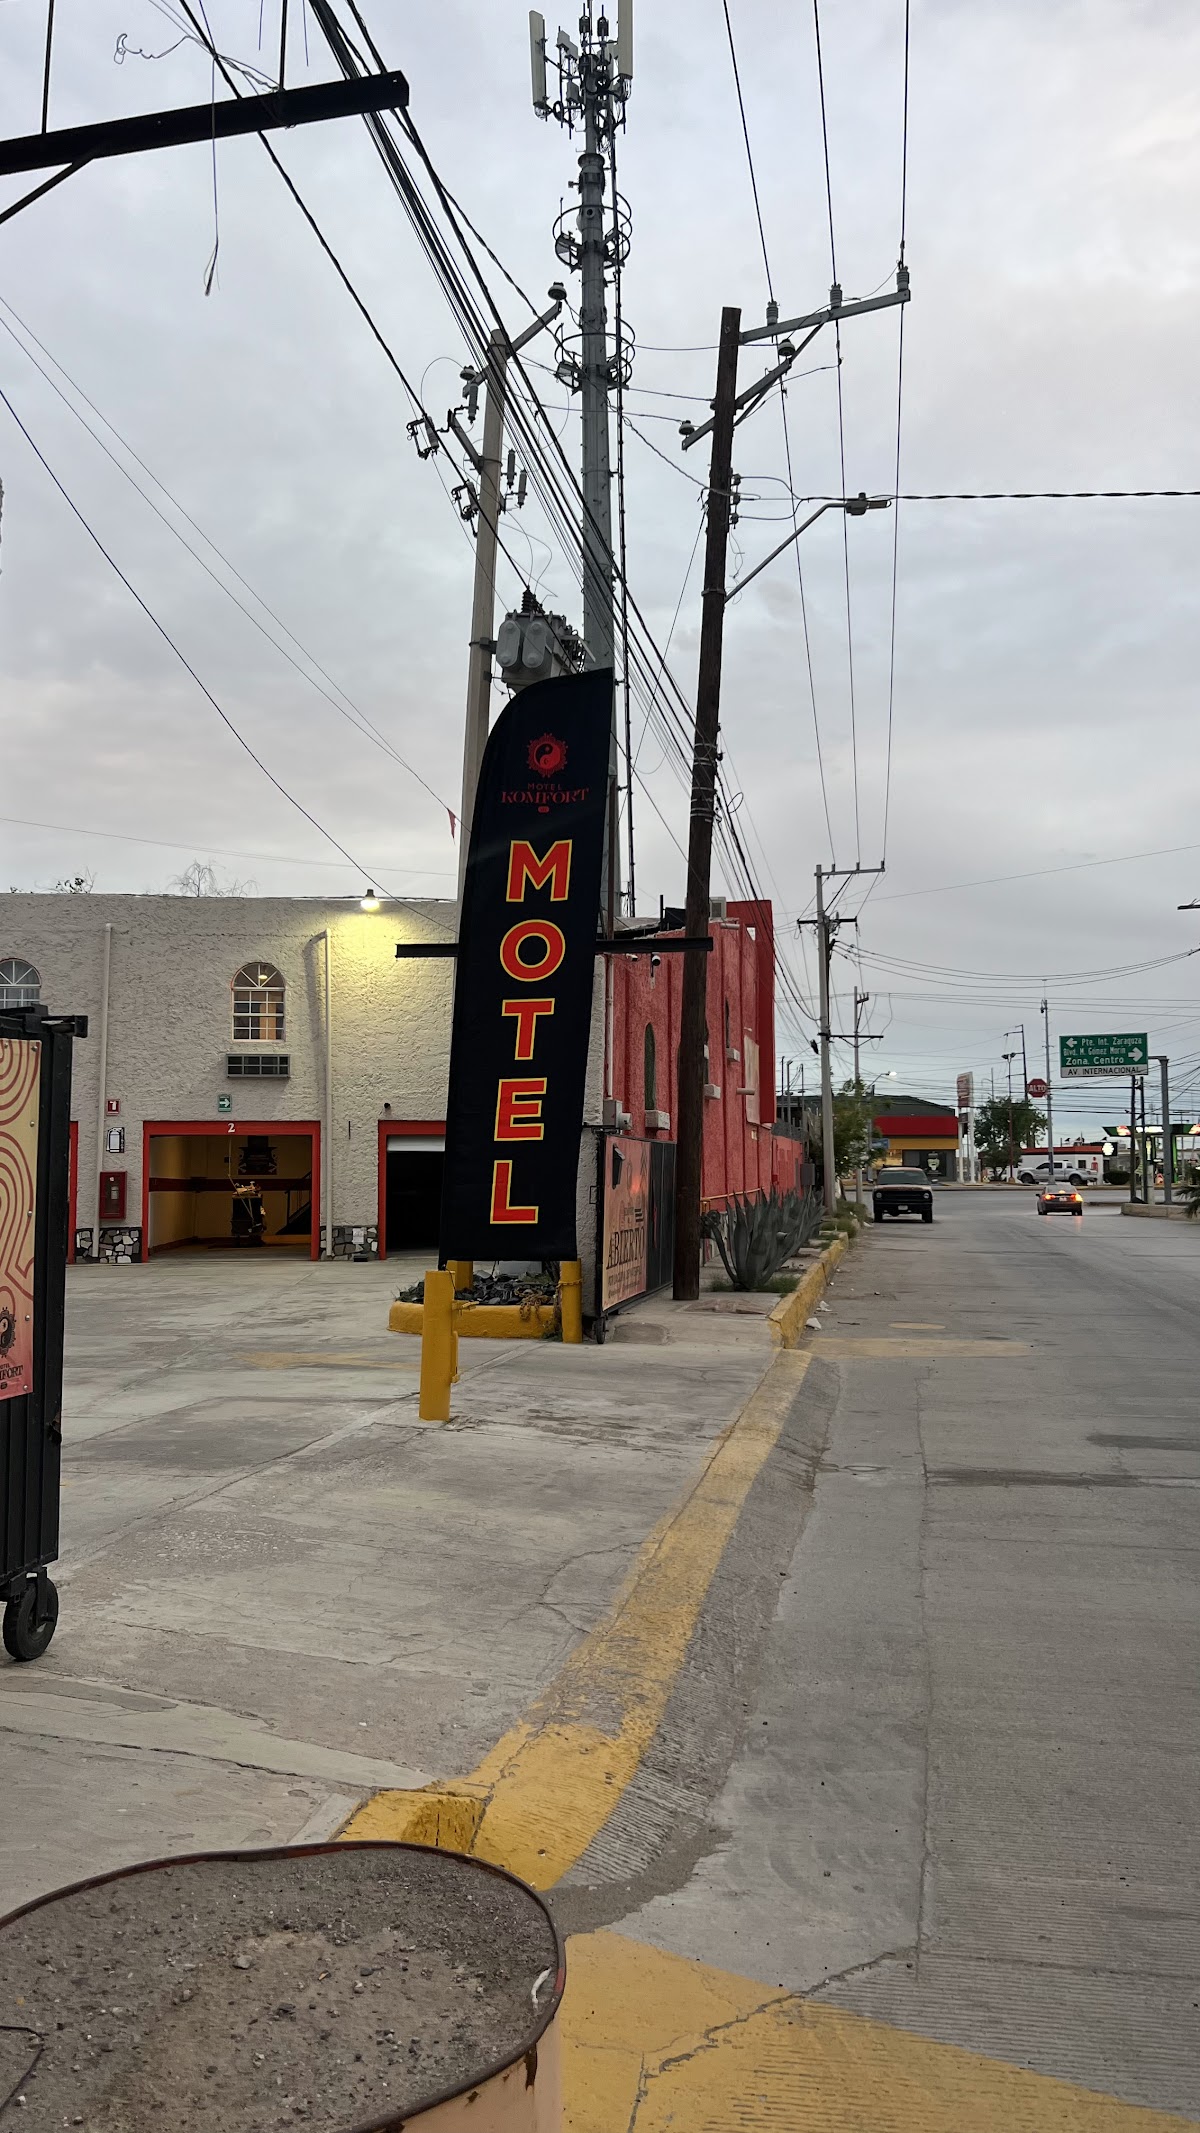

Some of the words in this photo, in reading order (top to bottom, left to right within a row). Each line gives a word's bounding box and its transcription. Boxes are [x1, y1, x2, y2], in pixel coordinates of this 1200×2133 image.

[527, 783, 562, 791] MOTEL
[501, 788, 590, 804] KOMFORT
[489, 839, 573, 1224] MOTEL
[1081, 1038, 1095, 1047] Pte.
[1097, 1038, 1109, 1046] Int.
[1112, 1037, 1142, 1047] Zaragoza
[1094, 1056, 1124, 1064] Centro
[1082, 1066, 1141, 1075] INTERNACIONAL
[227, 1122, 236, 1133] 2
[606, 1226, 645, 1270] ABIERTO
